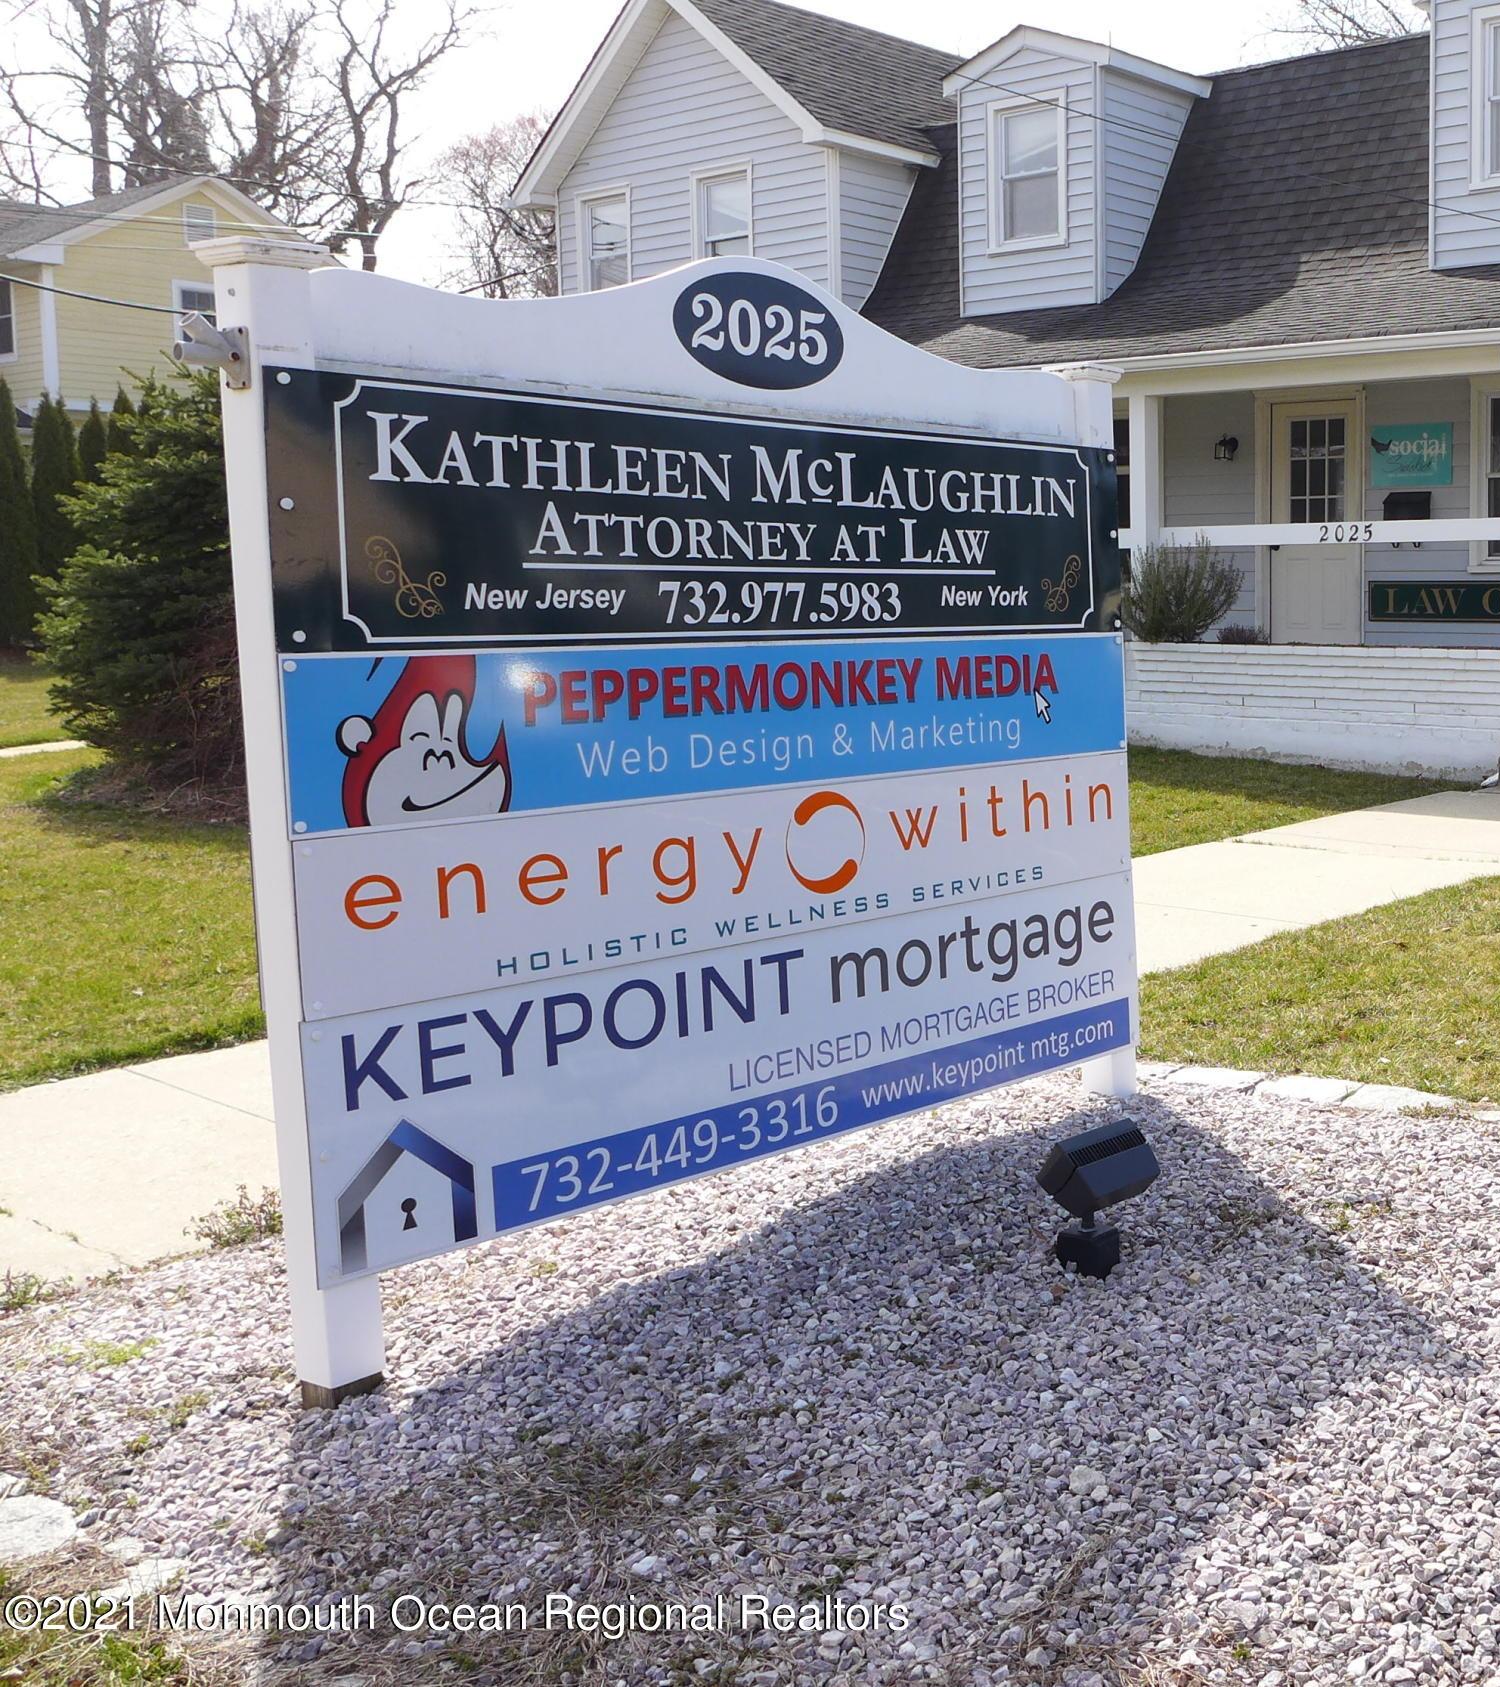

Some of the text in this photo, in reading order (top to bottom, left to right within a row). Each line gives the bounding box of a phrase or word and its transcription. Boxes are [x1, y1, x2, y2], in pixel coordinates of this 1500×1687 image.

[691, 292, 828, 366] 2025
[1389, 432, 1448, 459] social
[831, 523, 887, 562] AT
[1319, 523, 1373, 543] 2025
[464, 582, 626, 615] New Jersey
[658, 580, 901, 625] 732.977.5983
[941, 585, 1029, 607] New York
[1385, 588, 1465, 615] LAW
[523, 653, 1059, 727] PEPPERMONKEY MEDIA
[577, 713, 1022, 778] Web Design & Marketing
[344, 774, 1113, 930] energy within
[497, 865, 1044, 977] HOLISTIC WELLNESS SERVICES
[341, 900, 1115, 1111] KEYPOINT mortgage
[729, 969, 1115, 1092] LICENSED MORTGAGE BROKER
[520, 1085, 839, 1212] 732-449-3316
